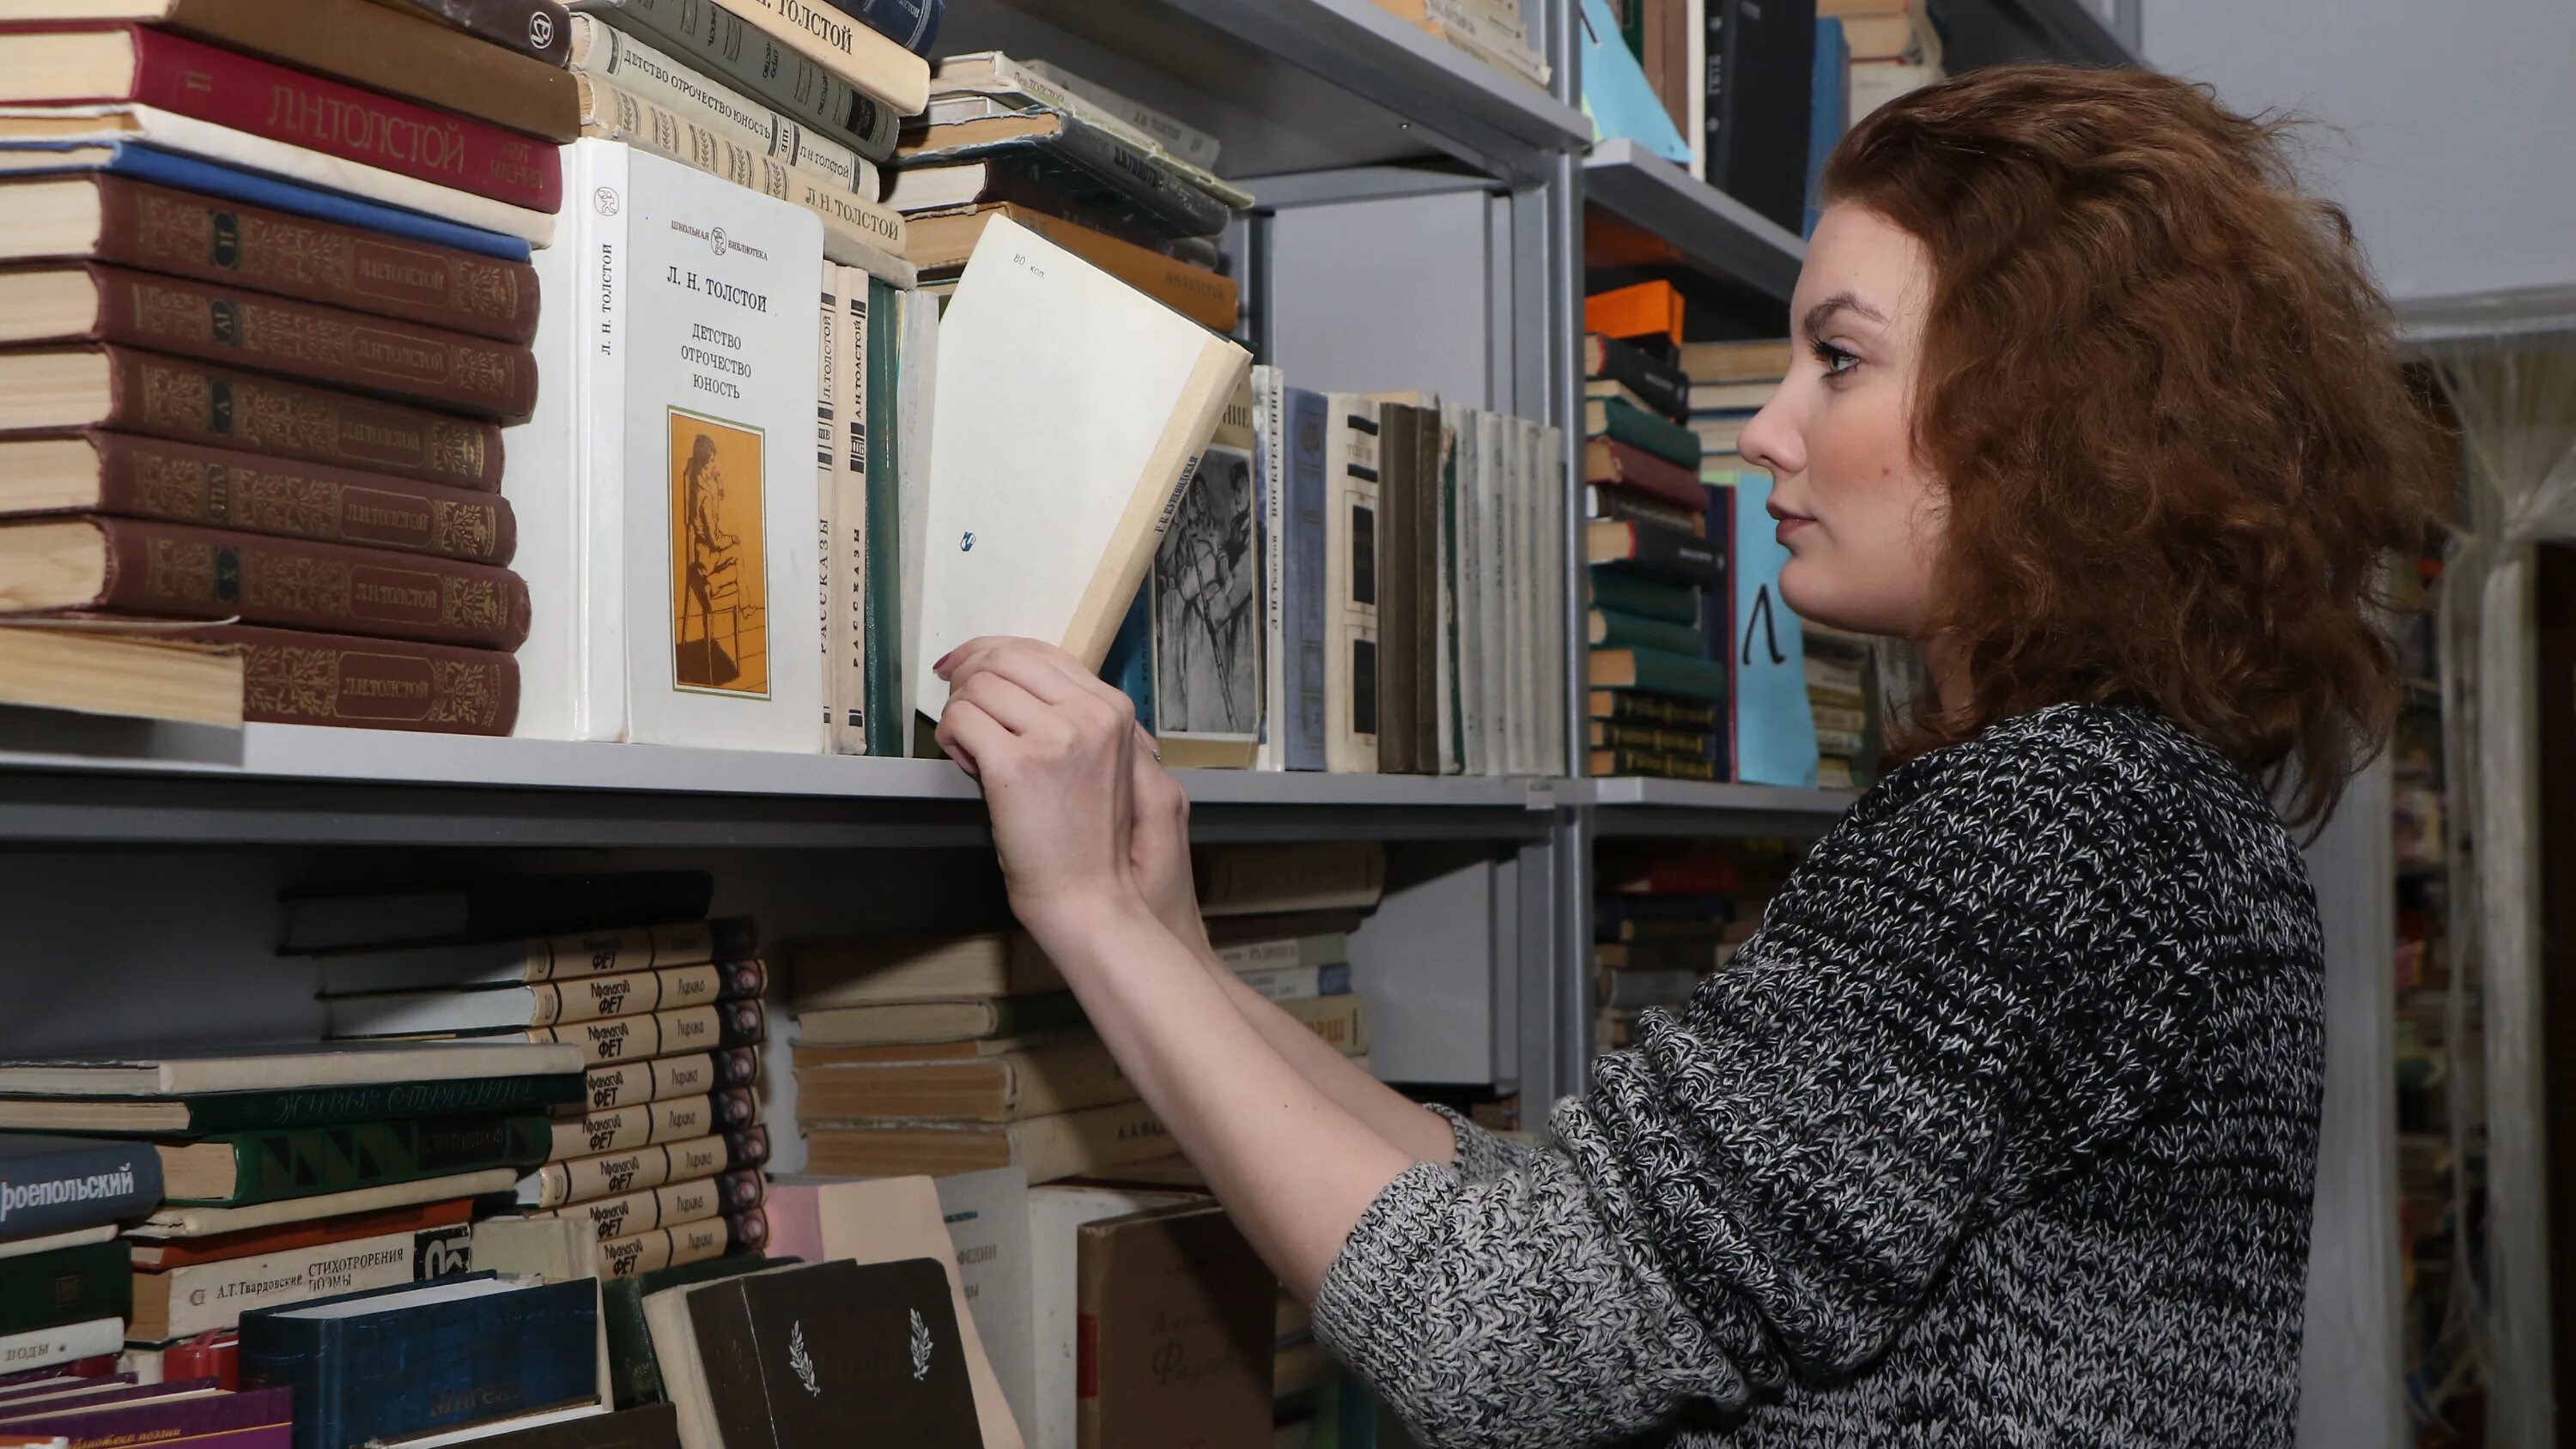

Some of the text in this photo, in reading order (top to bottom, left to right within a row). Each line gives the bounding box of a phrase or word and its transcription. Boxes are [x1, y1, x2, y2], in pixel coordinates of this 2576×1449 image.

[623, 49, 770, 139] ДЕТСТВО ОТРОЧЕСТВО ЮНОСТЬ
[265, 85, 465, 174] Л.Н.ТОЛСТОЙ
[781, 129, 788, 153] ШБ
[671, 220, 769, 262] ШКОЛЬНАЯ БИБЛИОТЕКА
[667, 265, 769, 313] Л. Н. ТОЛСТОЙ
[602, 318, 612, 335] Н.
[692, 323, 742, 350] ДЕТСТВО
[681, 345, 752, 379] ОТРОЧЕСТВО
[692, 373, 740, 400] ЮНОСТЬ
[850, 440, 865, 455] ШБ
[1744, 584, 1785, 665] Л
[598, 995, 625, 1016] ФЕТ
[598, 1038, 623, 1058] ФЕТ
[587, 1070, 623, 1092] фанасий
[593, 1087, 618, 1108] ФЕТ
[589, 1130, 616, 1151] ФЕТ
[0, 1162, 135, 1222] роепольский
[609, 1172, 634, 1191] ФЕТ
[598, 1217, 623, 1239] ФЕТ
[613, 1255, 637, 1276] ФЕТ
[308, 1273, 351, 1293] ПОЭМЫ
[5, 1343, 50, 1362] ВОДЫ
